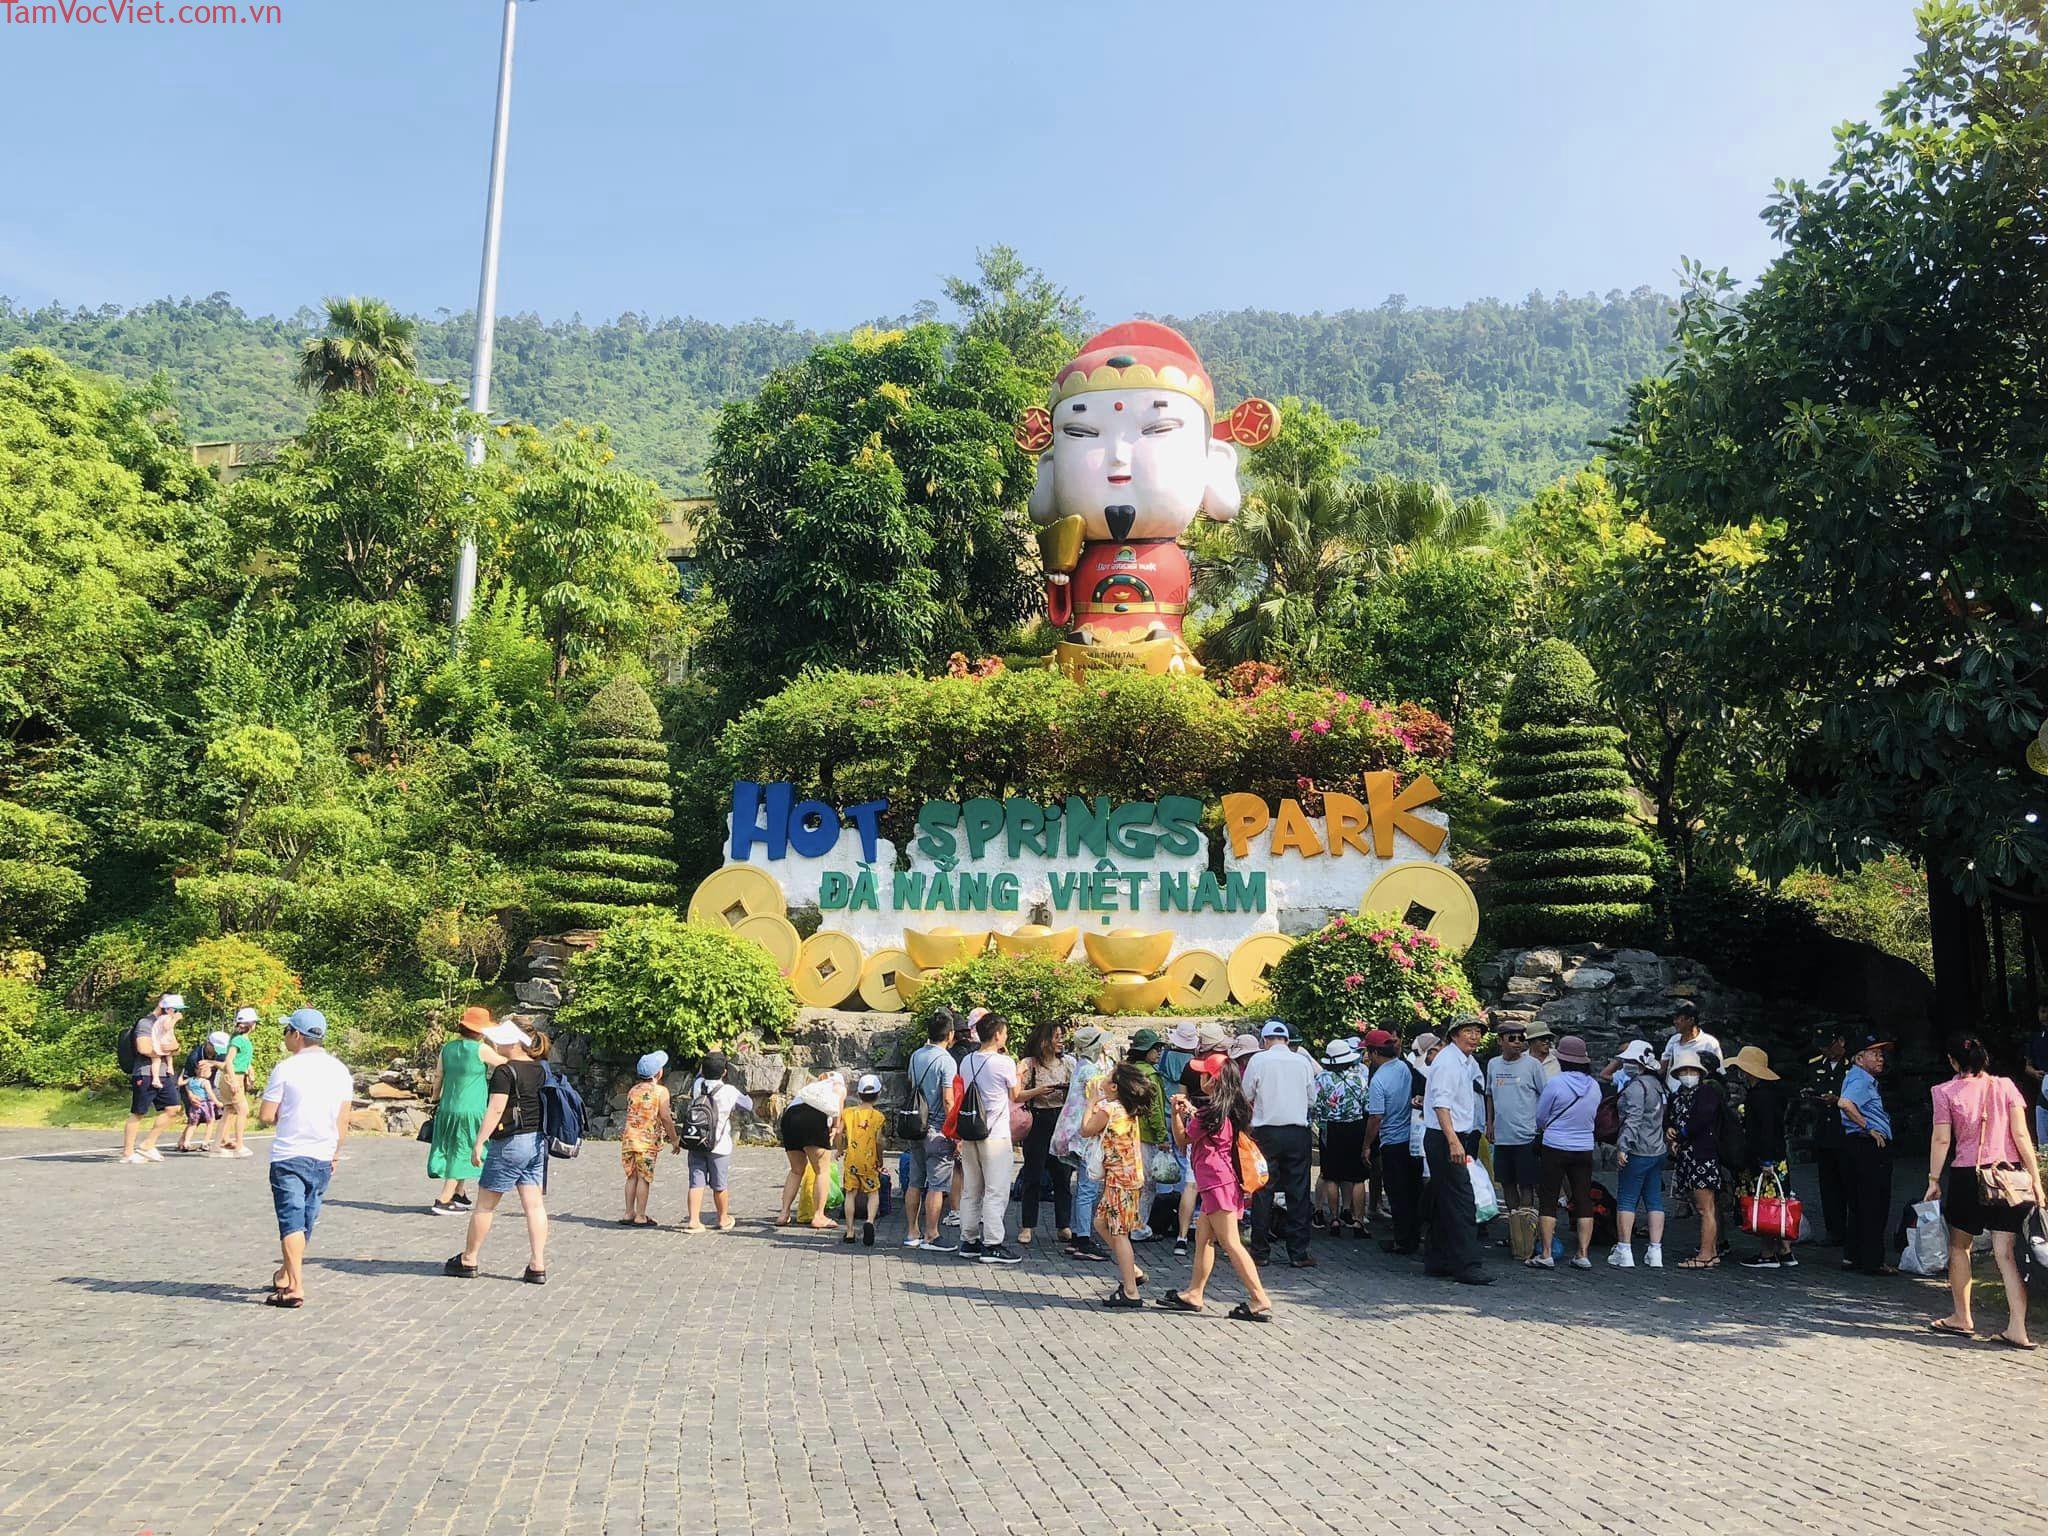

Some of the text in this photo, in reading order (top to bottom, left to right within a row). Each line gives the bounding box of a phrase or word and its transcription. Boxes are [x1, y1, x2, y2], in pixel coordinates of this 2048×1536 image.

[731, 780, 888, 862] HOT
[1221, 771, 1448, 858] PARK
[819, 861, 880, 911] ĐÀ
[1048, 858, 1148, 925] VIỆT
[1159, 871, 1267, 912] NAM
